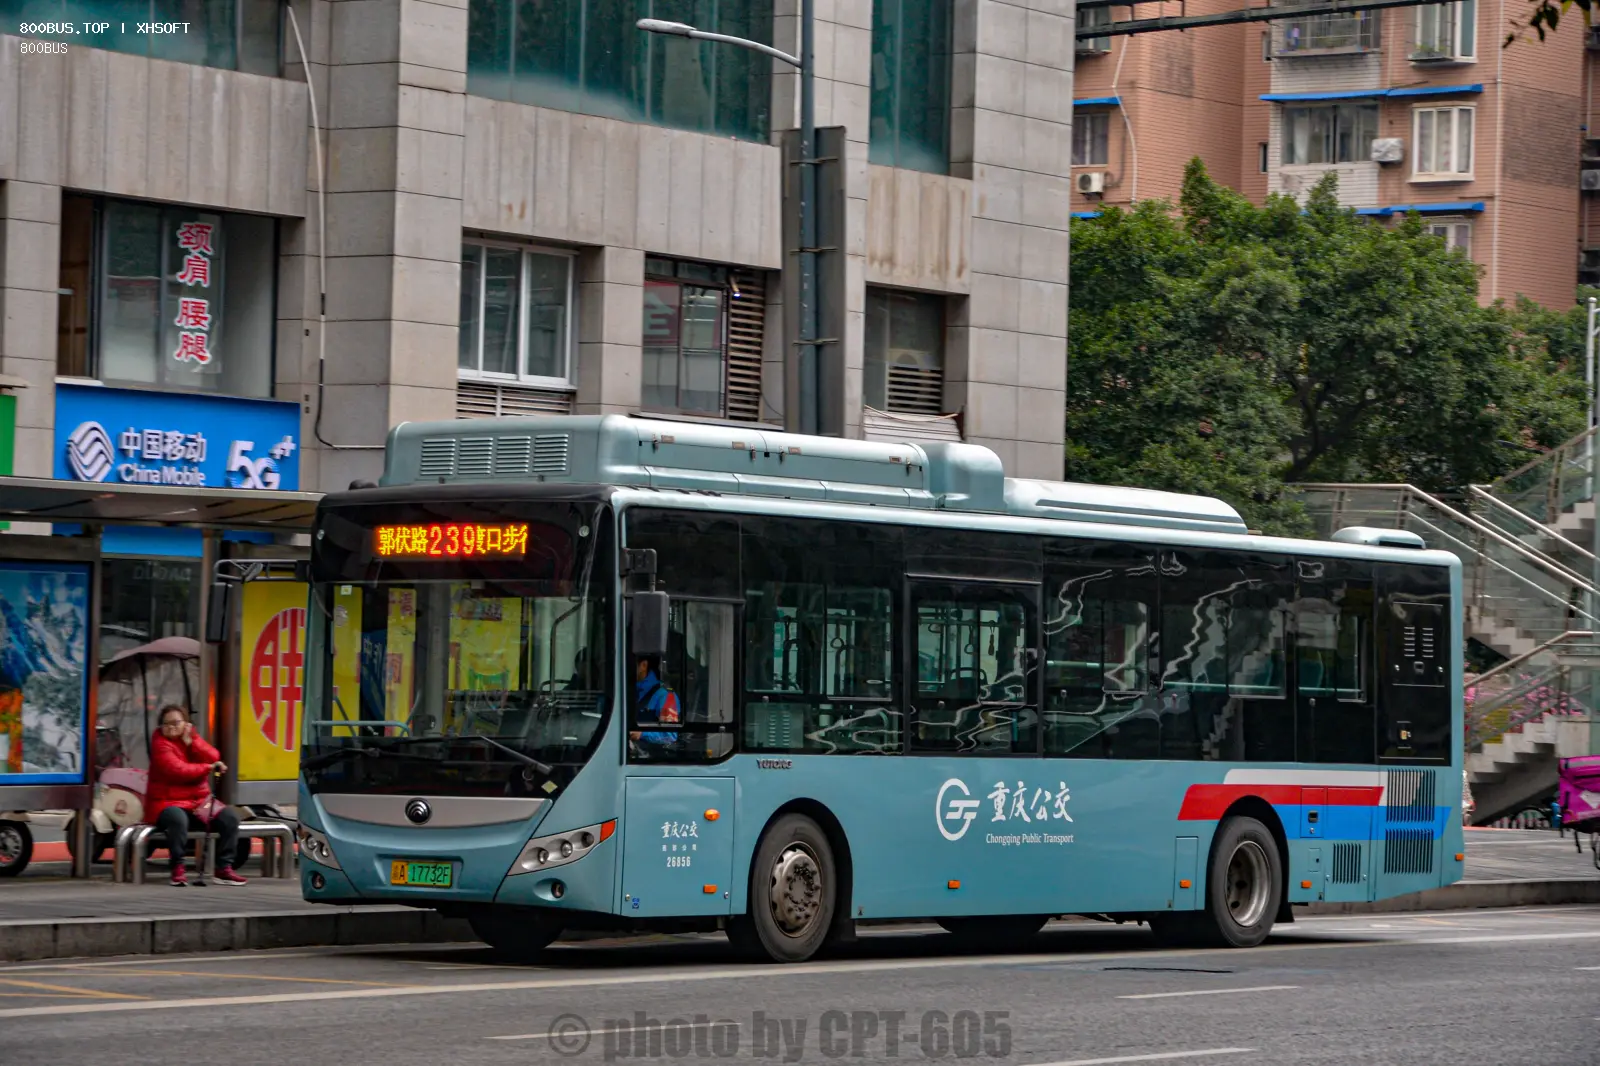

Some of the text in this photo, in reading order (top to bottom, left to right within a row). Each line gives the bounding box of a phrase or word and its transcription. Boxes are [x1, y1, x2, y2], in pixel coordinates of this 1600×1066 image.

[118, 427, 207, 462] 中国移动
[117, 463, 206, 486] China Mobile
[429, 526, 475, 555] 239
[987, 781, 1074, 822] 重庆公交
[661, 820, 699, 838] 重庆公交
[986, 832, 1074, 846] Chongqing Public Transport
[667, 856, 691, 868] 26856
